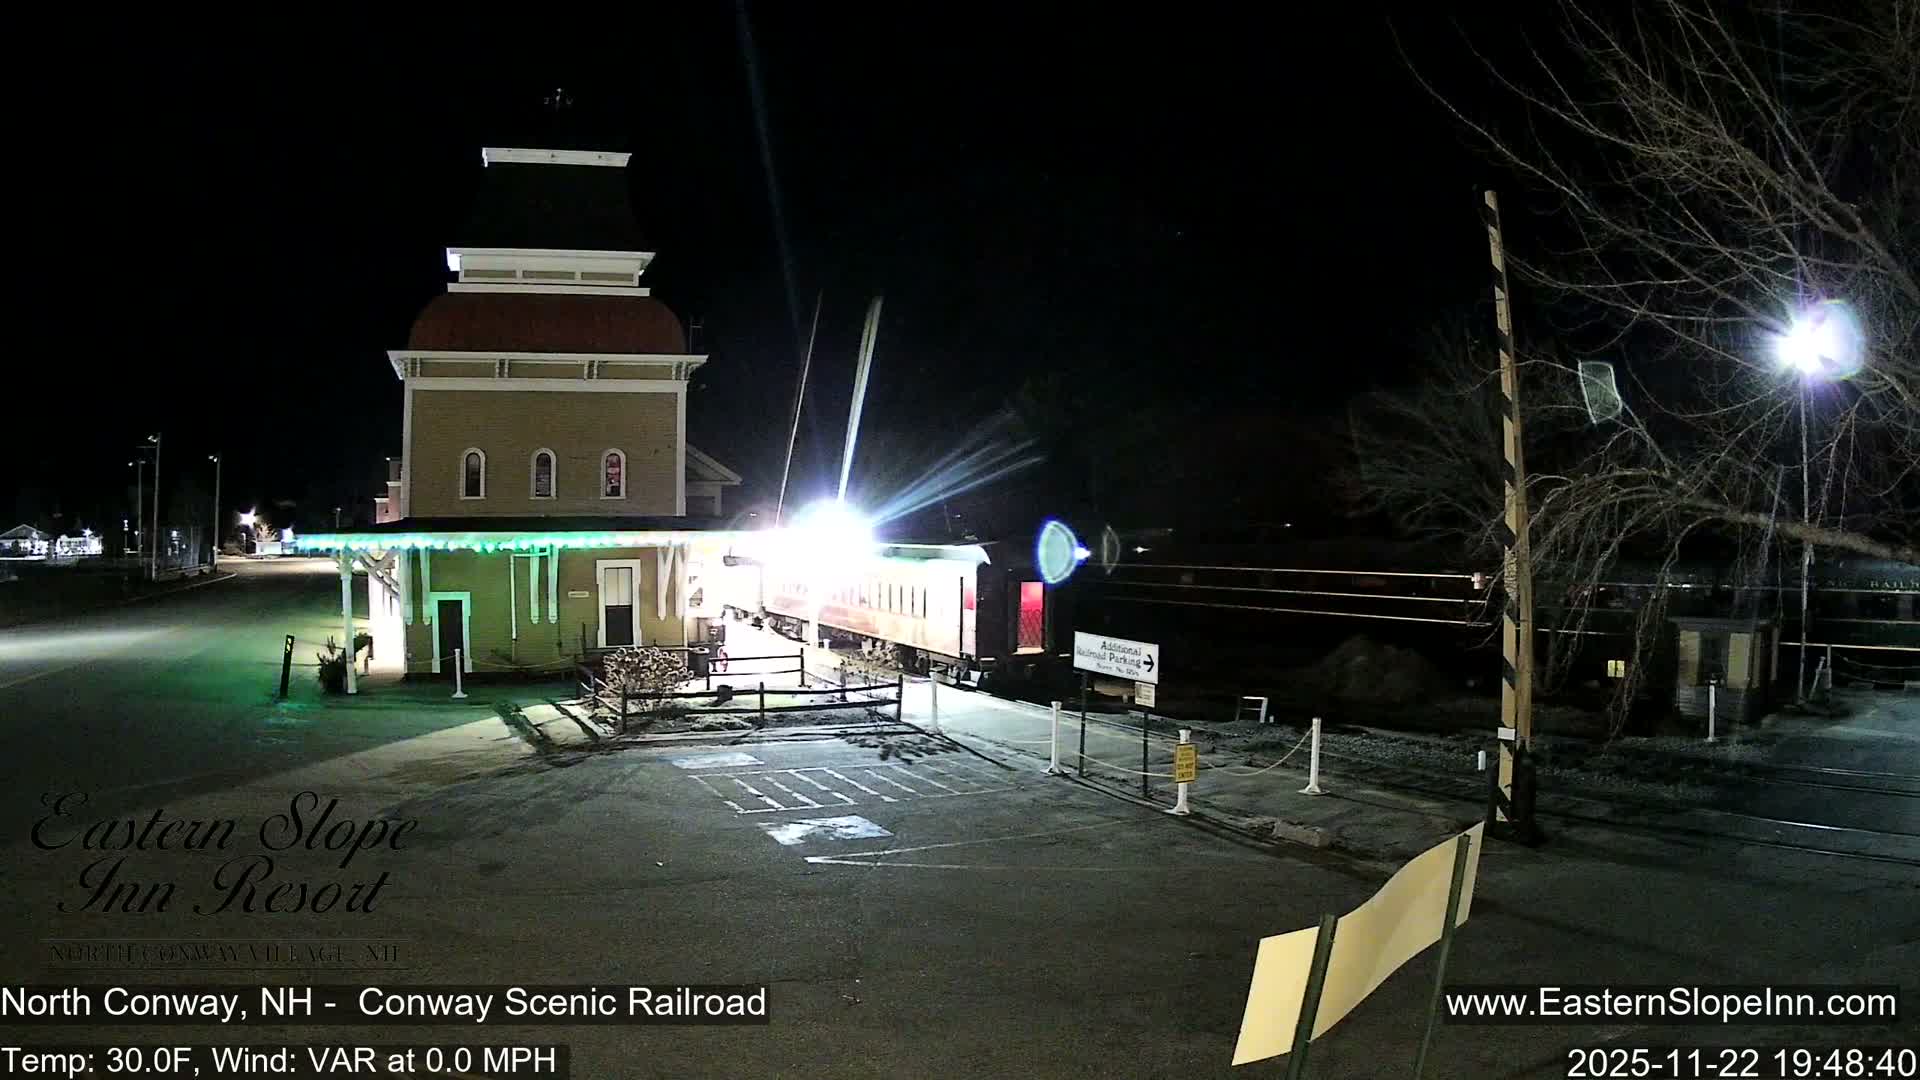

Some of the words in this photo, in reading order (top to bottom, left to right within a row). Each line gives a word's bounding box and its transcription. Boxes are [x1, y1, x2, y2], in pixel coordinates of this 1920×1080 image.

[1076, 645, 1106, 660] Railroad
[1108, 652, 1142, 669] Parking
[1100, 640, 1142, 657] Additional
